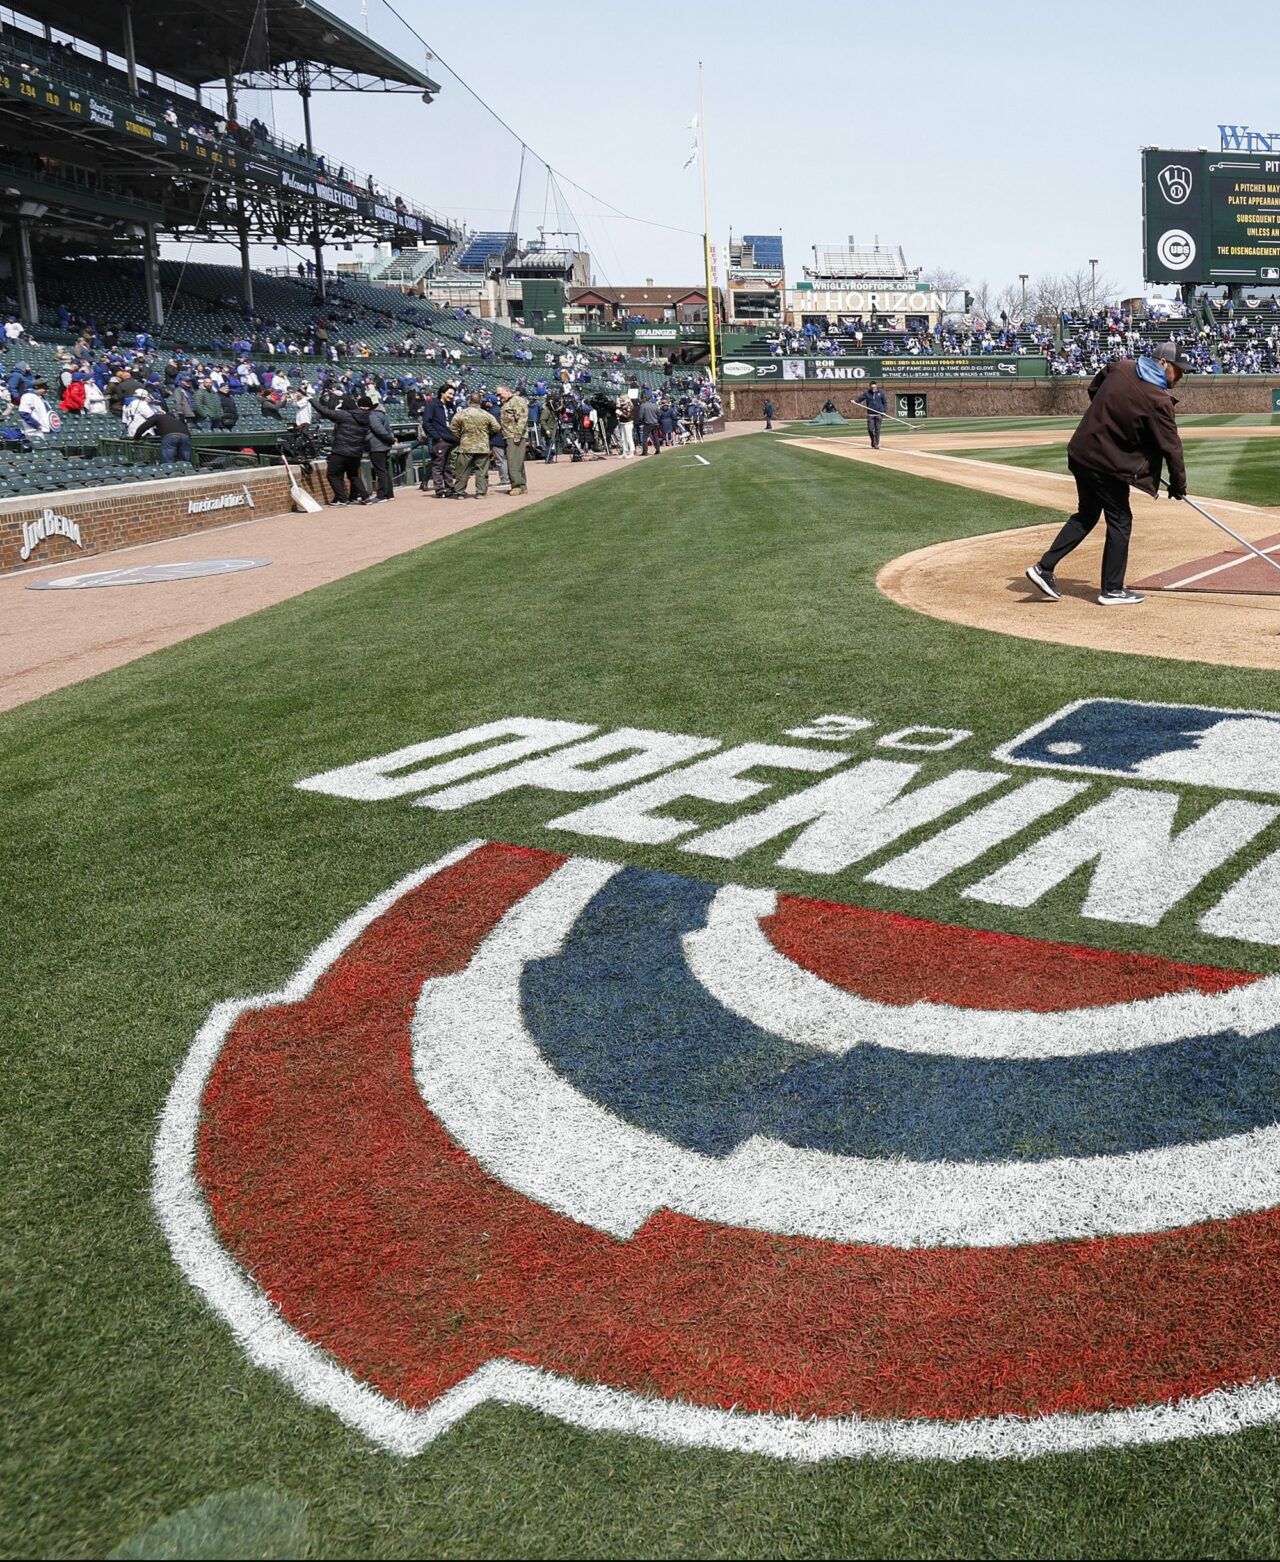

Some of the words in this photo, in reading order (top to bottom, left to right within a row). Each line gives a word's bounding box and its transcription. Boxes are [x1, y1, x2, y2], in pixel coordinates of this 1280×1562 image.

[281, 170, 308, 193] Welcome
[315, 182, 343, 205] WRIGLEY
[342, 193, 358, 210] FIELD
[1235, 184, 1240, 192] A
[1240, 184, 1266, 193] PITCHER
[1267, 184, 1280, 193] MAY
[1228, 196, 1247, 205] PLATE
[1236, 214, 1275, 224] SUBSEQUENT
[1247, 227, 1270, 237] UNLESS
[1271, 228, 1279, 237] AN
[1217, 246, 1229, 255] THE
[1230, 247, 1280, 257] DISENGAGEMENT
[812, 282, 916, 291] WRIGLEYROOFTOPS.COM
[826, 291, 947, 311] HORIZON
[634, 328, 677, 336] GRAINGER
[815, 368, 866, 379] SANTO
[188, 496, 222, 514] American
[221, 493, 245, 510] Airlines
[20, 517, 46, 561] JIM
[44, 508, 83, 549] BEAM
[784, 714, 974, 752] 20
